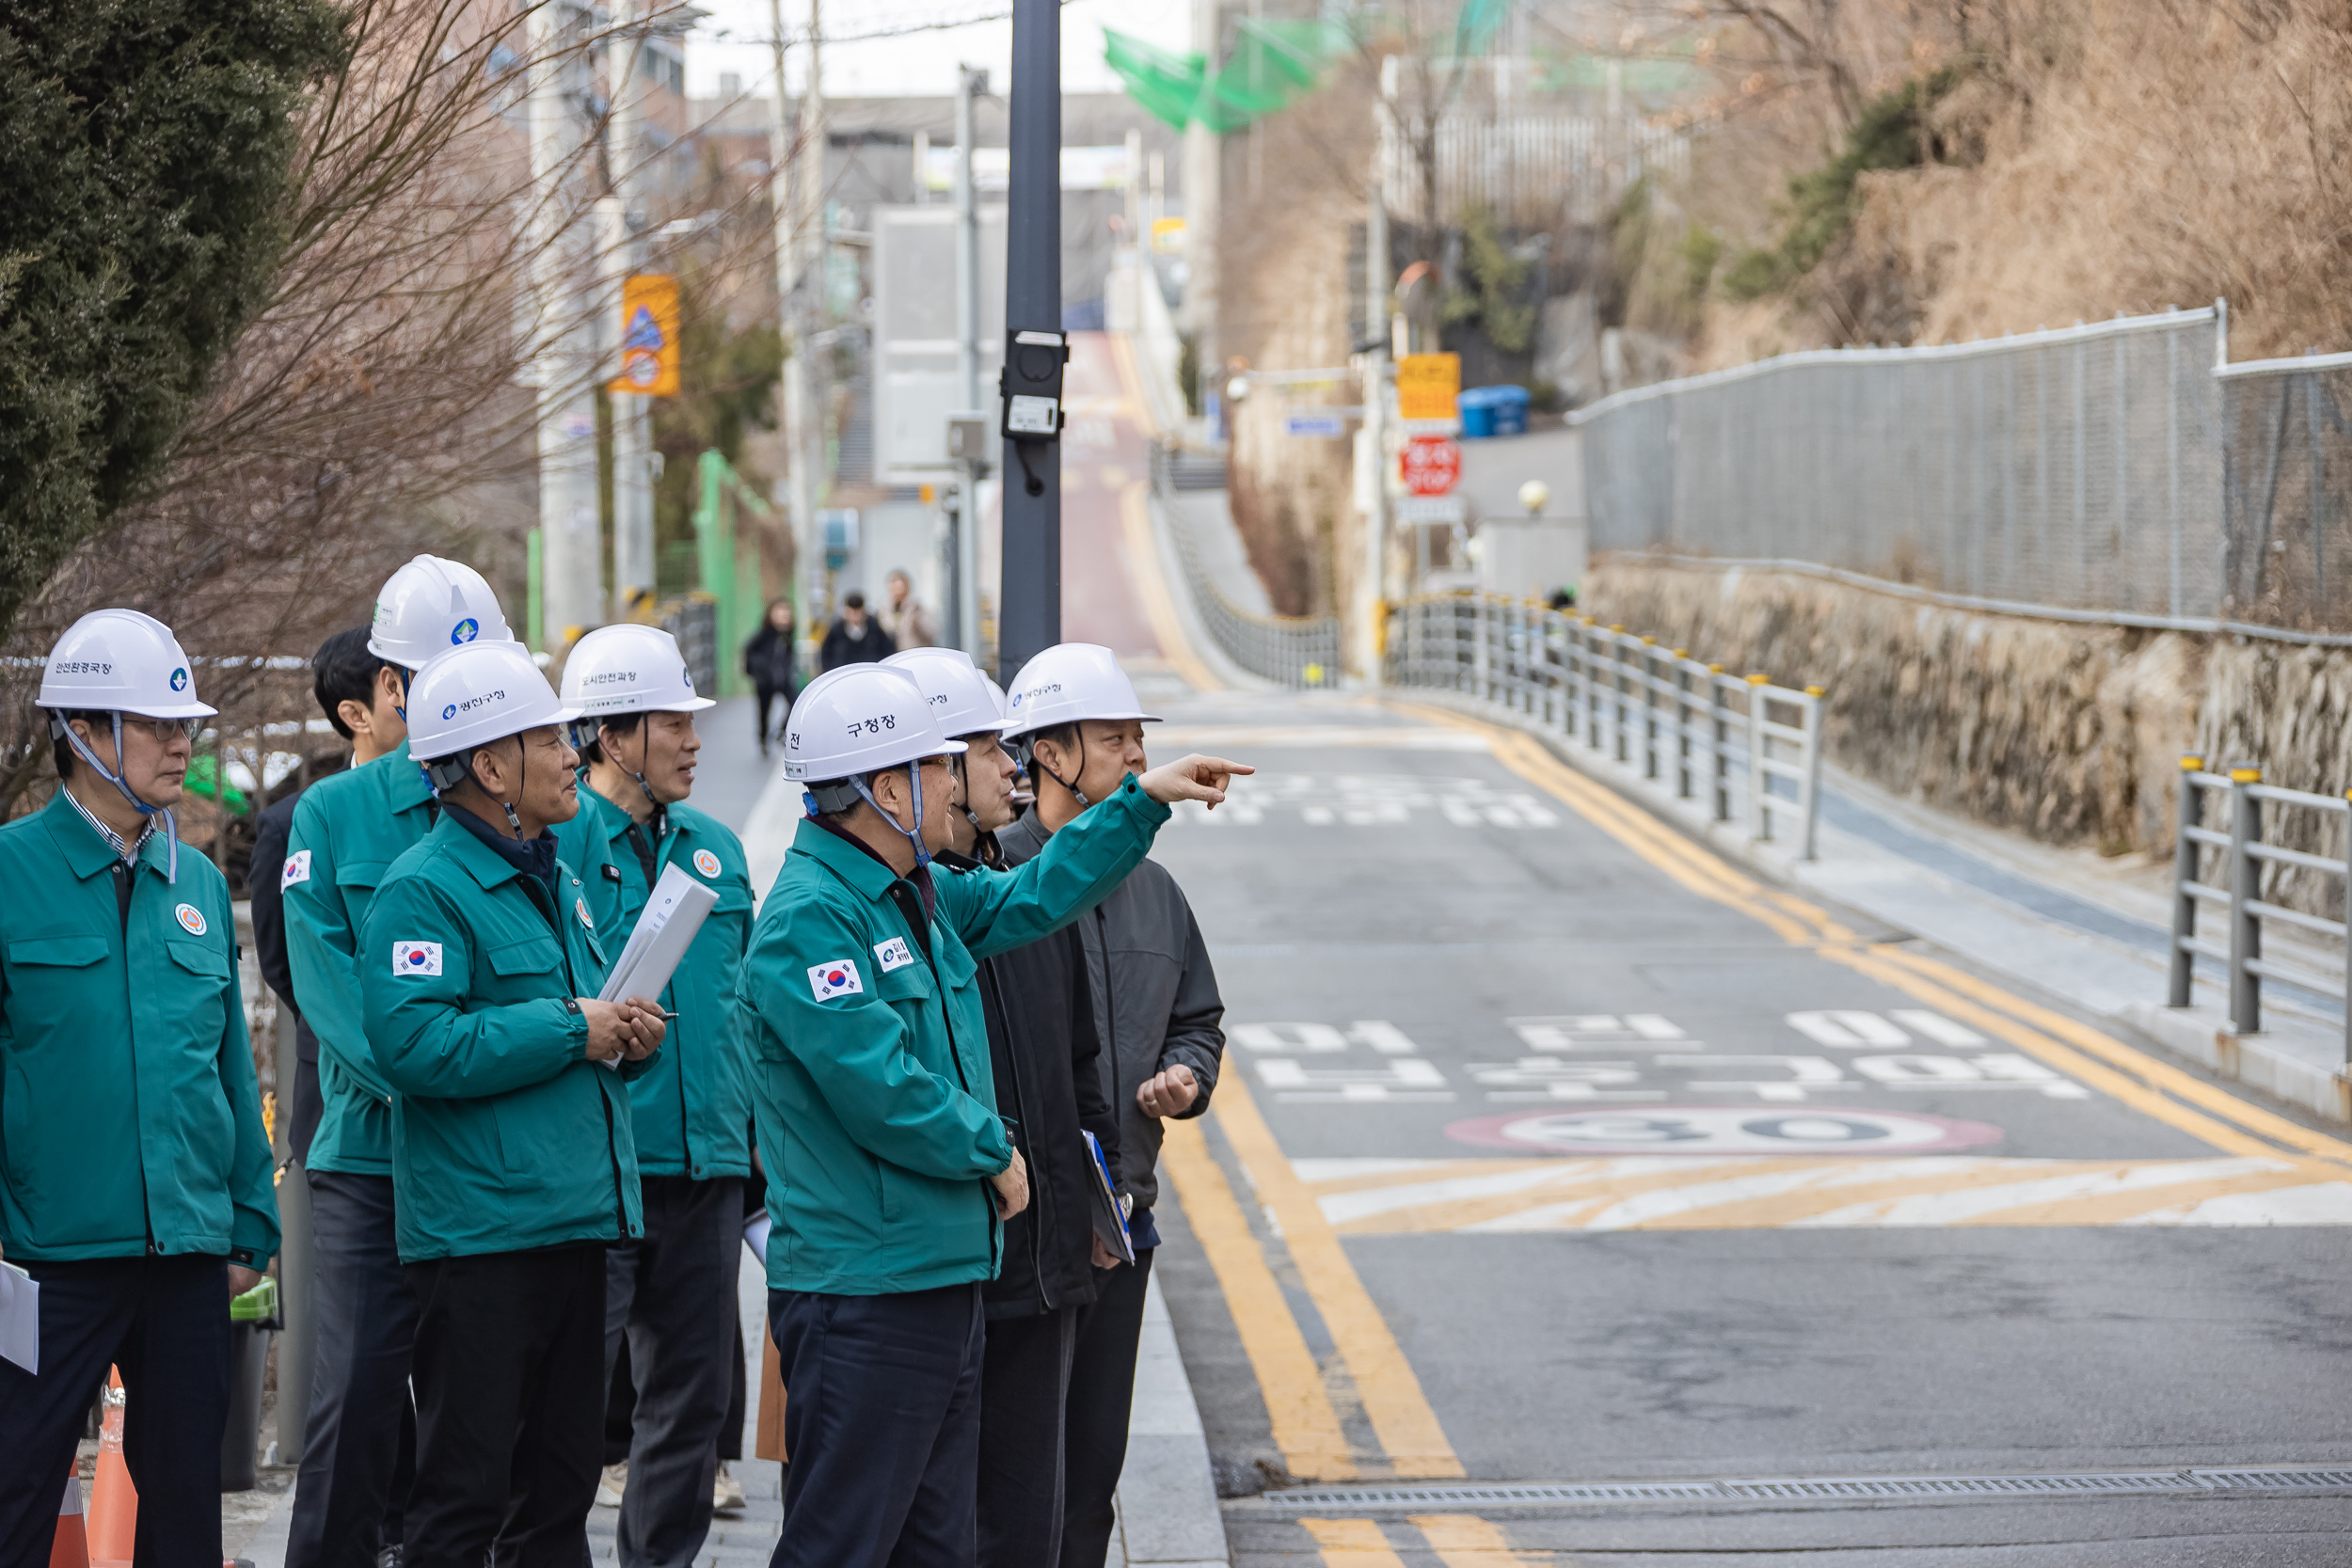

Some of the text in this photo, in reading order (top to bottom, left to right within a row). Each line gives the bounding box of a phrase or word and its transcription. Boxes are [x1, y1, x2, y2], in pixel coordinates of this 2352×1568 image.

[56, 662, 112, 674] 안전환경국장
[582, 672, 636, 686] 도시안전과장
[459, 689, 505, 712] 광진구청
[847, 714, 895, 737] 구청장
[1230, 1009, 1990, 1053] 어린이
[1254, 1053, 2090, 1103] 보호구역
[1537, 1114, 1893, 1142] 30
